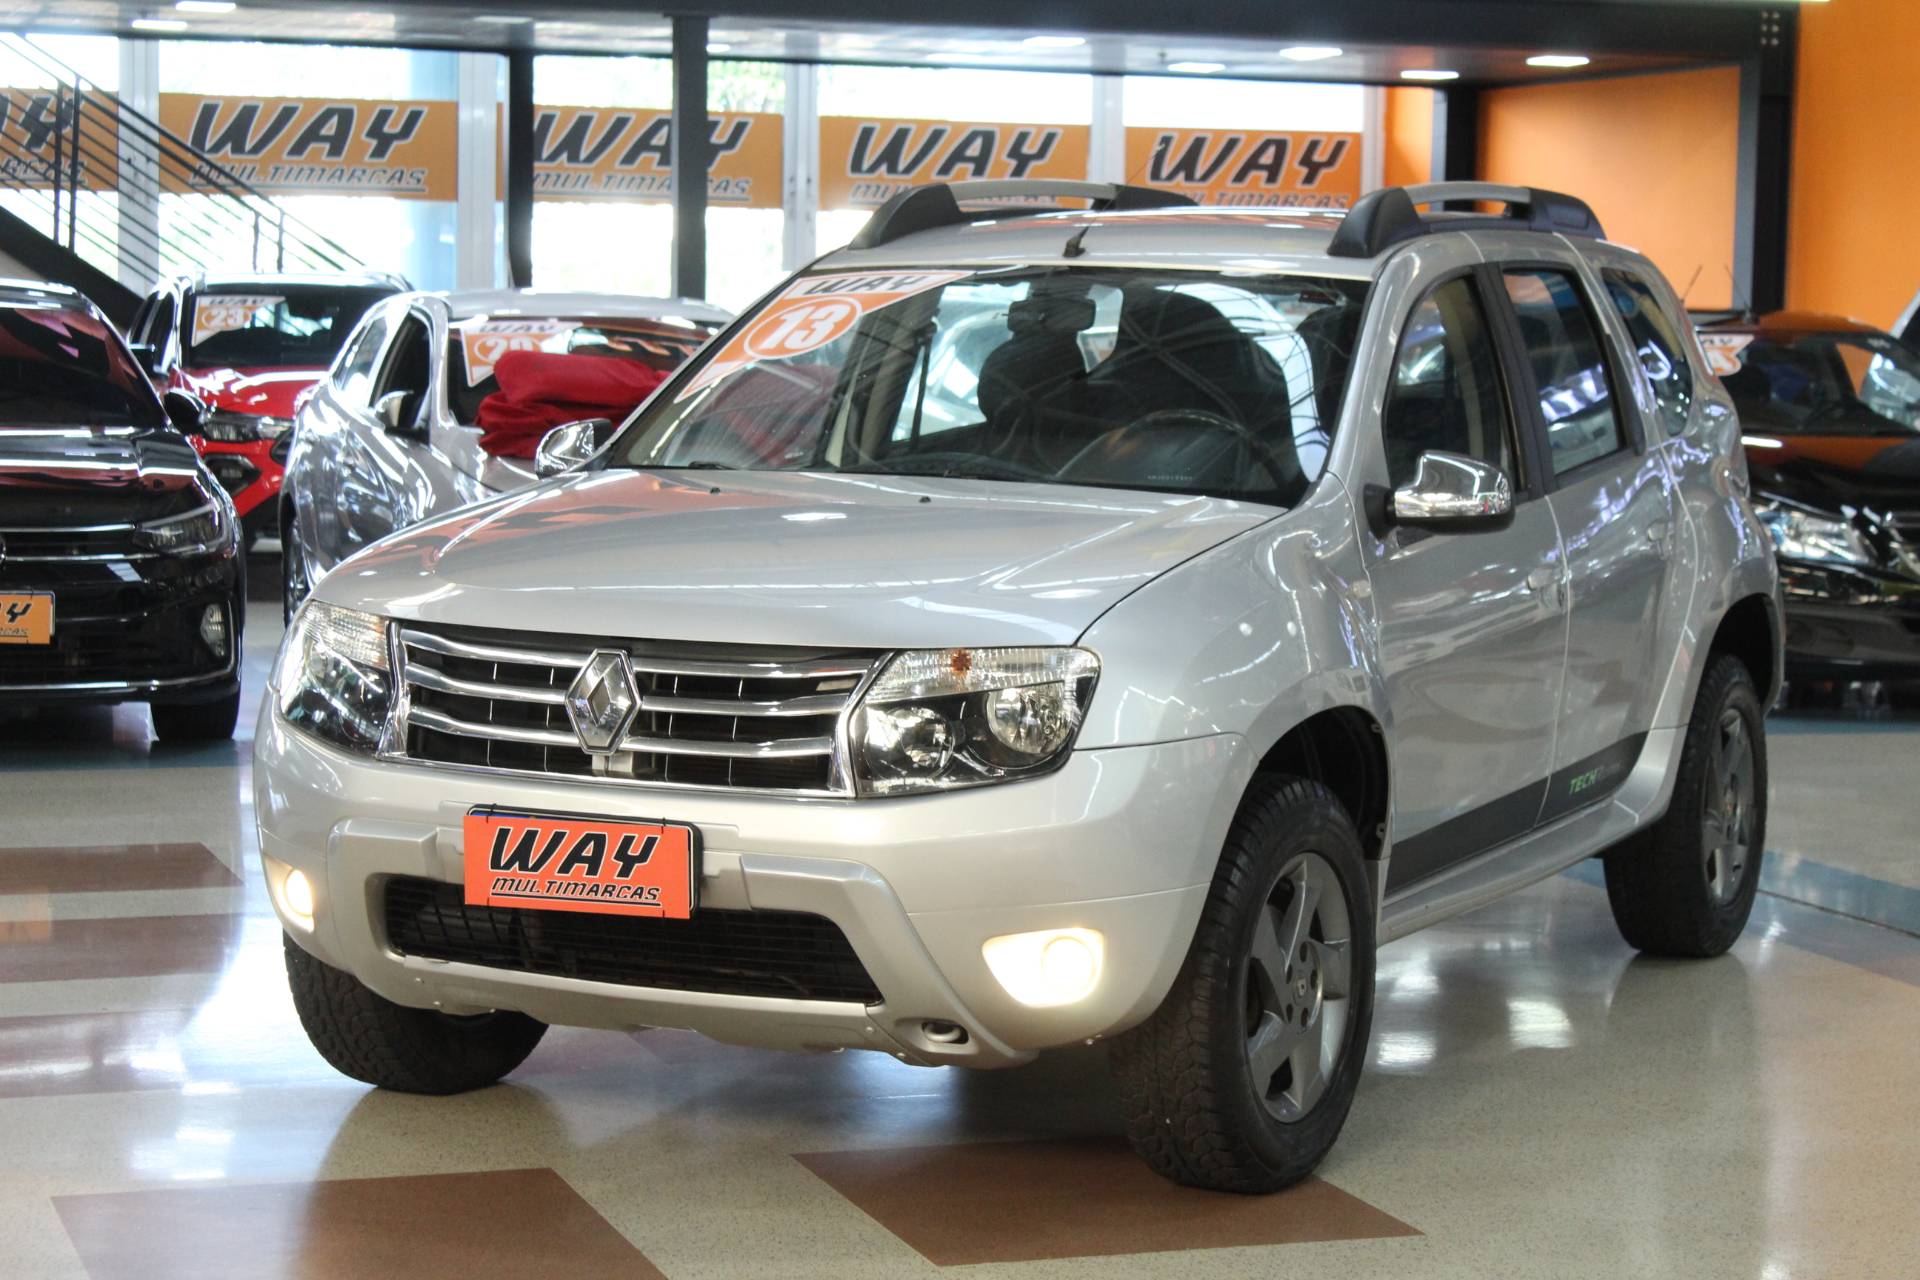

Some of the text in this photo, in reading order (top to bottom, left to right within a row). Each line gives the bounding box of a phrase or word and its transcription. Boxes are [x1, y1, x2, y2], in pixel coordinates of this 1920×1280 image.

[189, 101, 426, 161] WAY
[850, 126, 1059, 178] WAY
[1150, 135, 1348, 185] WAY
[804, 275, 928, 295] WAY
[757, 303, 851, 350] 13
[490, 826, 660, 879] WAY
[491, 877, 661, 901] MULTIMARCAS
